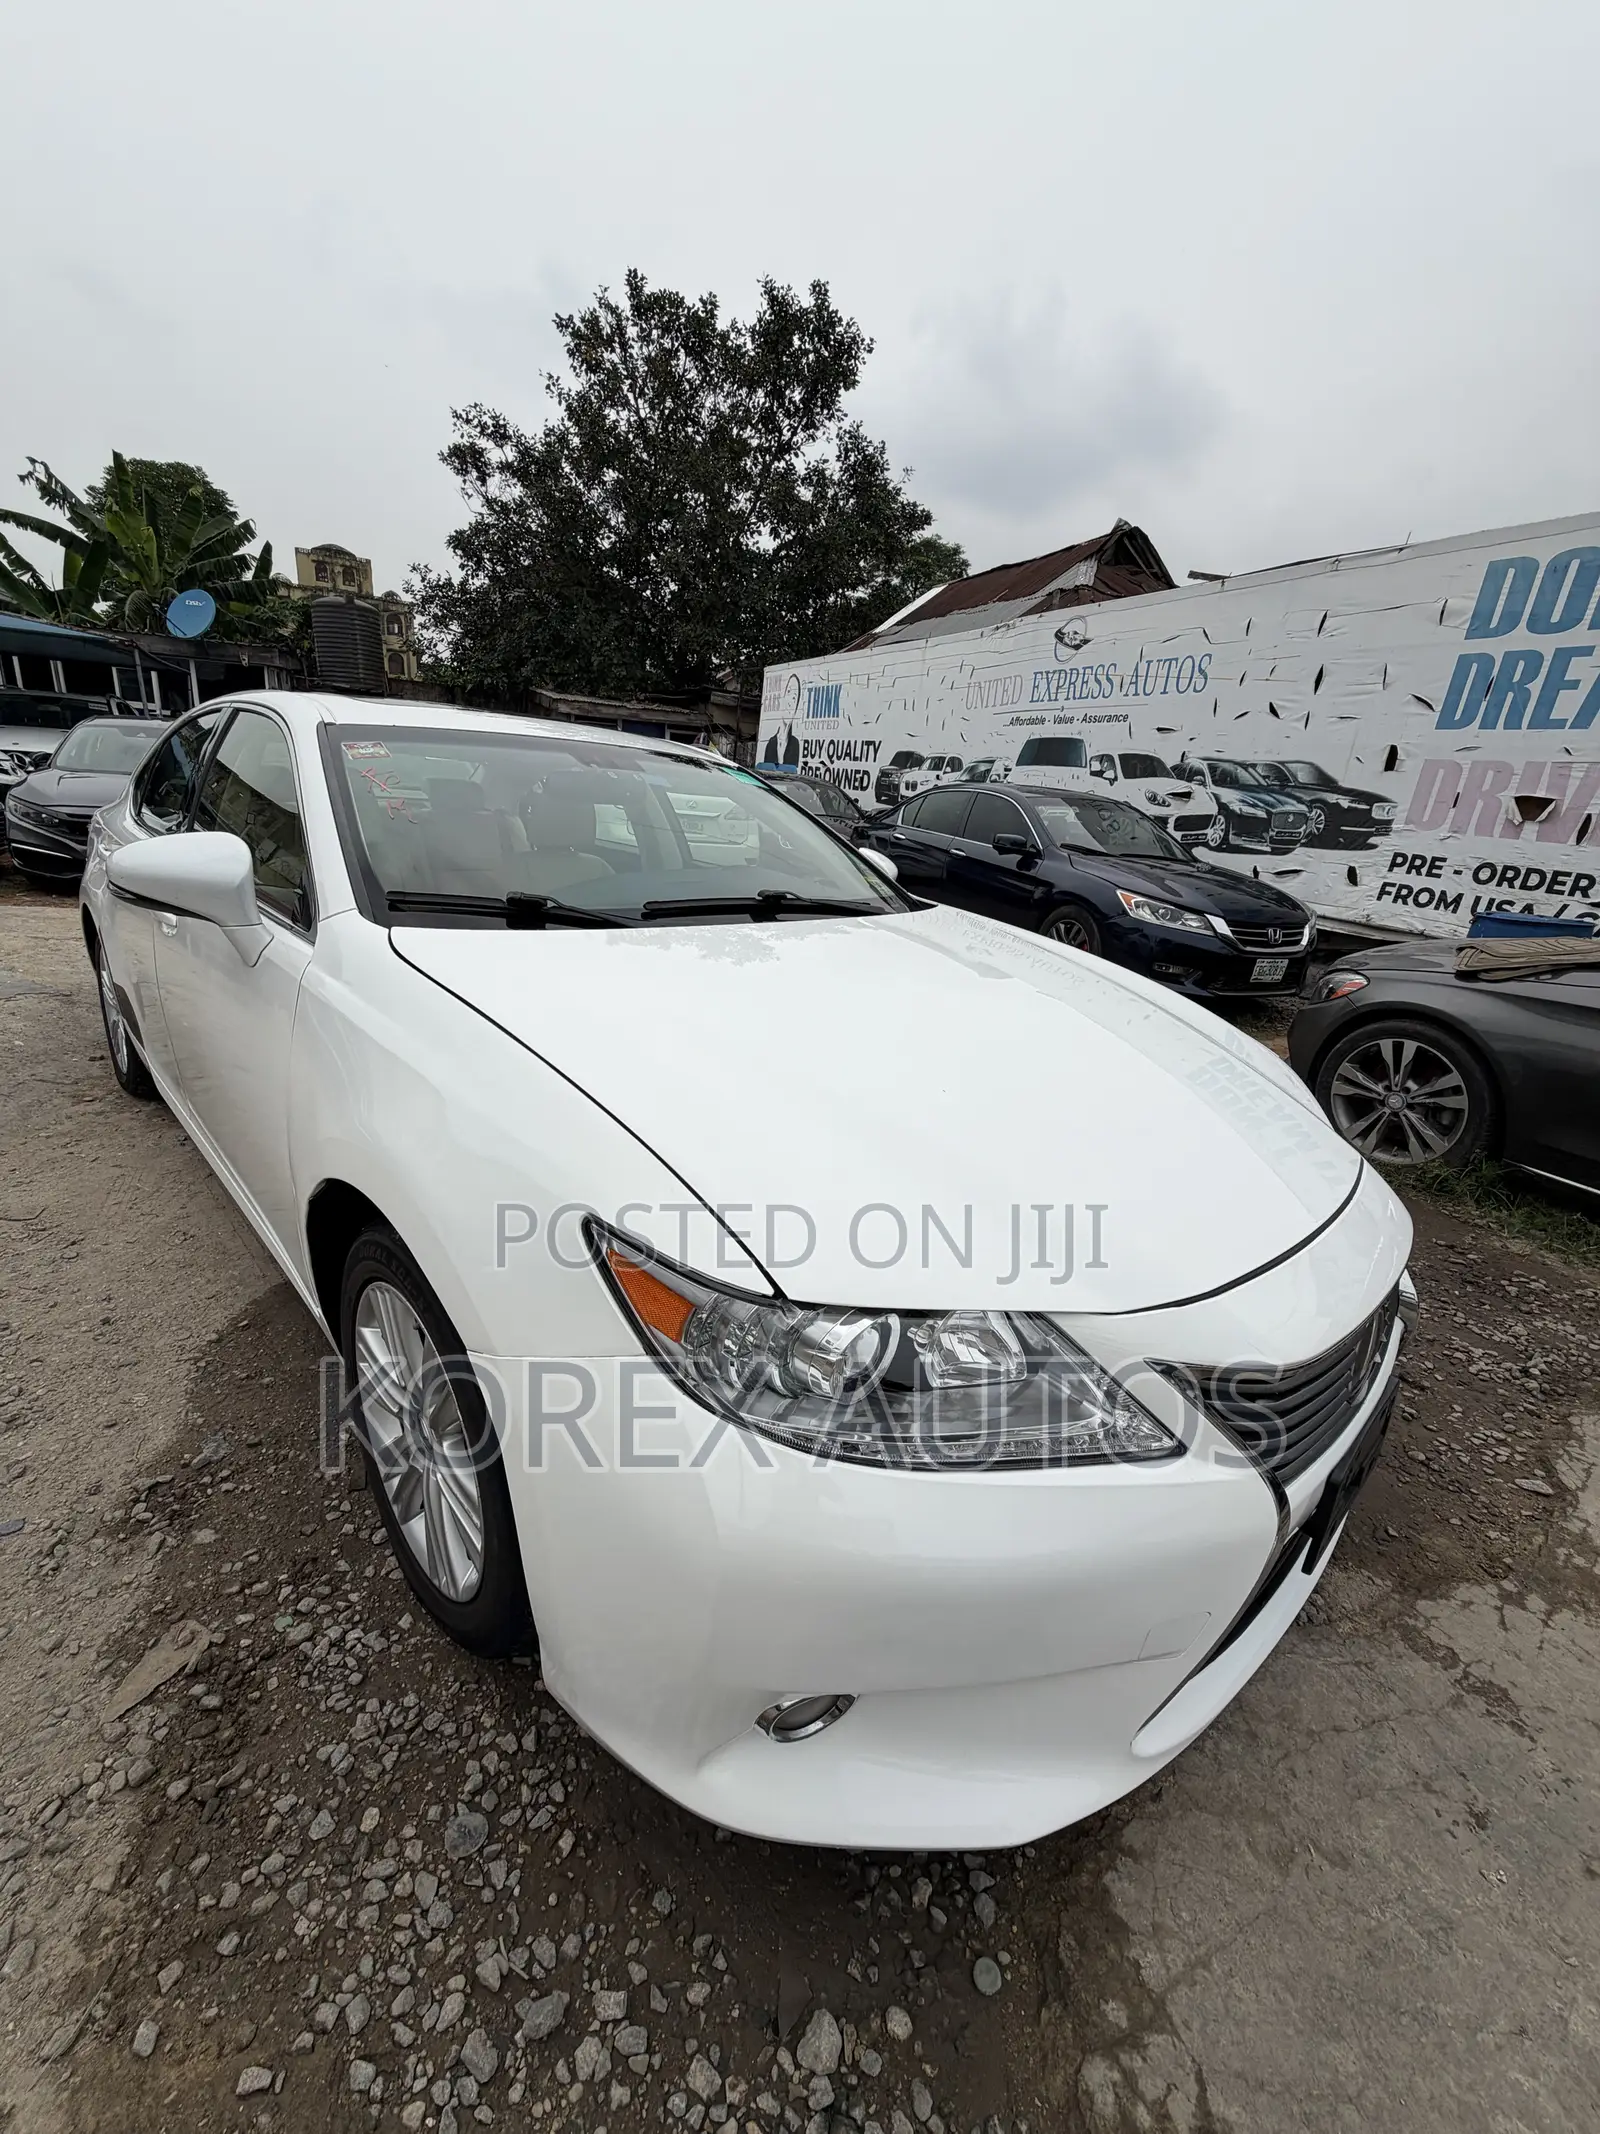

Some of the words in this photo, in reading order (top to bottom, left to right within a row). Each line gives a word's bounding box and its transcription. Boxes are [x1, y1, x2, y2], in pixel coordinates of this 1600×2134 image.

[964, 674, 1024, 710] UNITED
[1029, 662, 1118, 704] EXPRESS
[1123, 653, 1213, 698] AUTOS
[806, 684, 843, 719] THINK
[1053, 714, 1075, 725] Value
[1080, 712, 1129, 724] Assurance
[804, 720, 840, 731] UNITED
[802, 738, 826, 760] BUY
[827, 739, 882, 765] QUALITY
[1405, 758, 1600, 847] DRIV
[1387, 851, 1448, 879] PRE
[1472, 862, 1597, 899] ORDER
[1376, 881, 1465, 915] FROM
